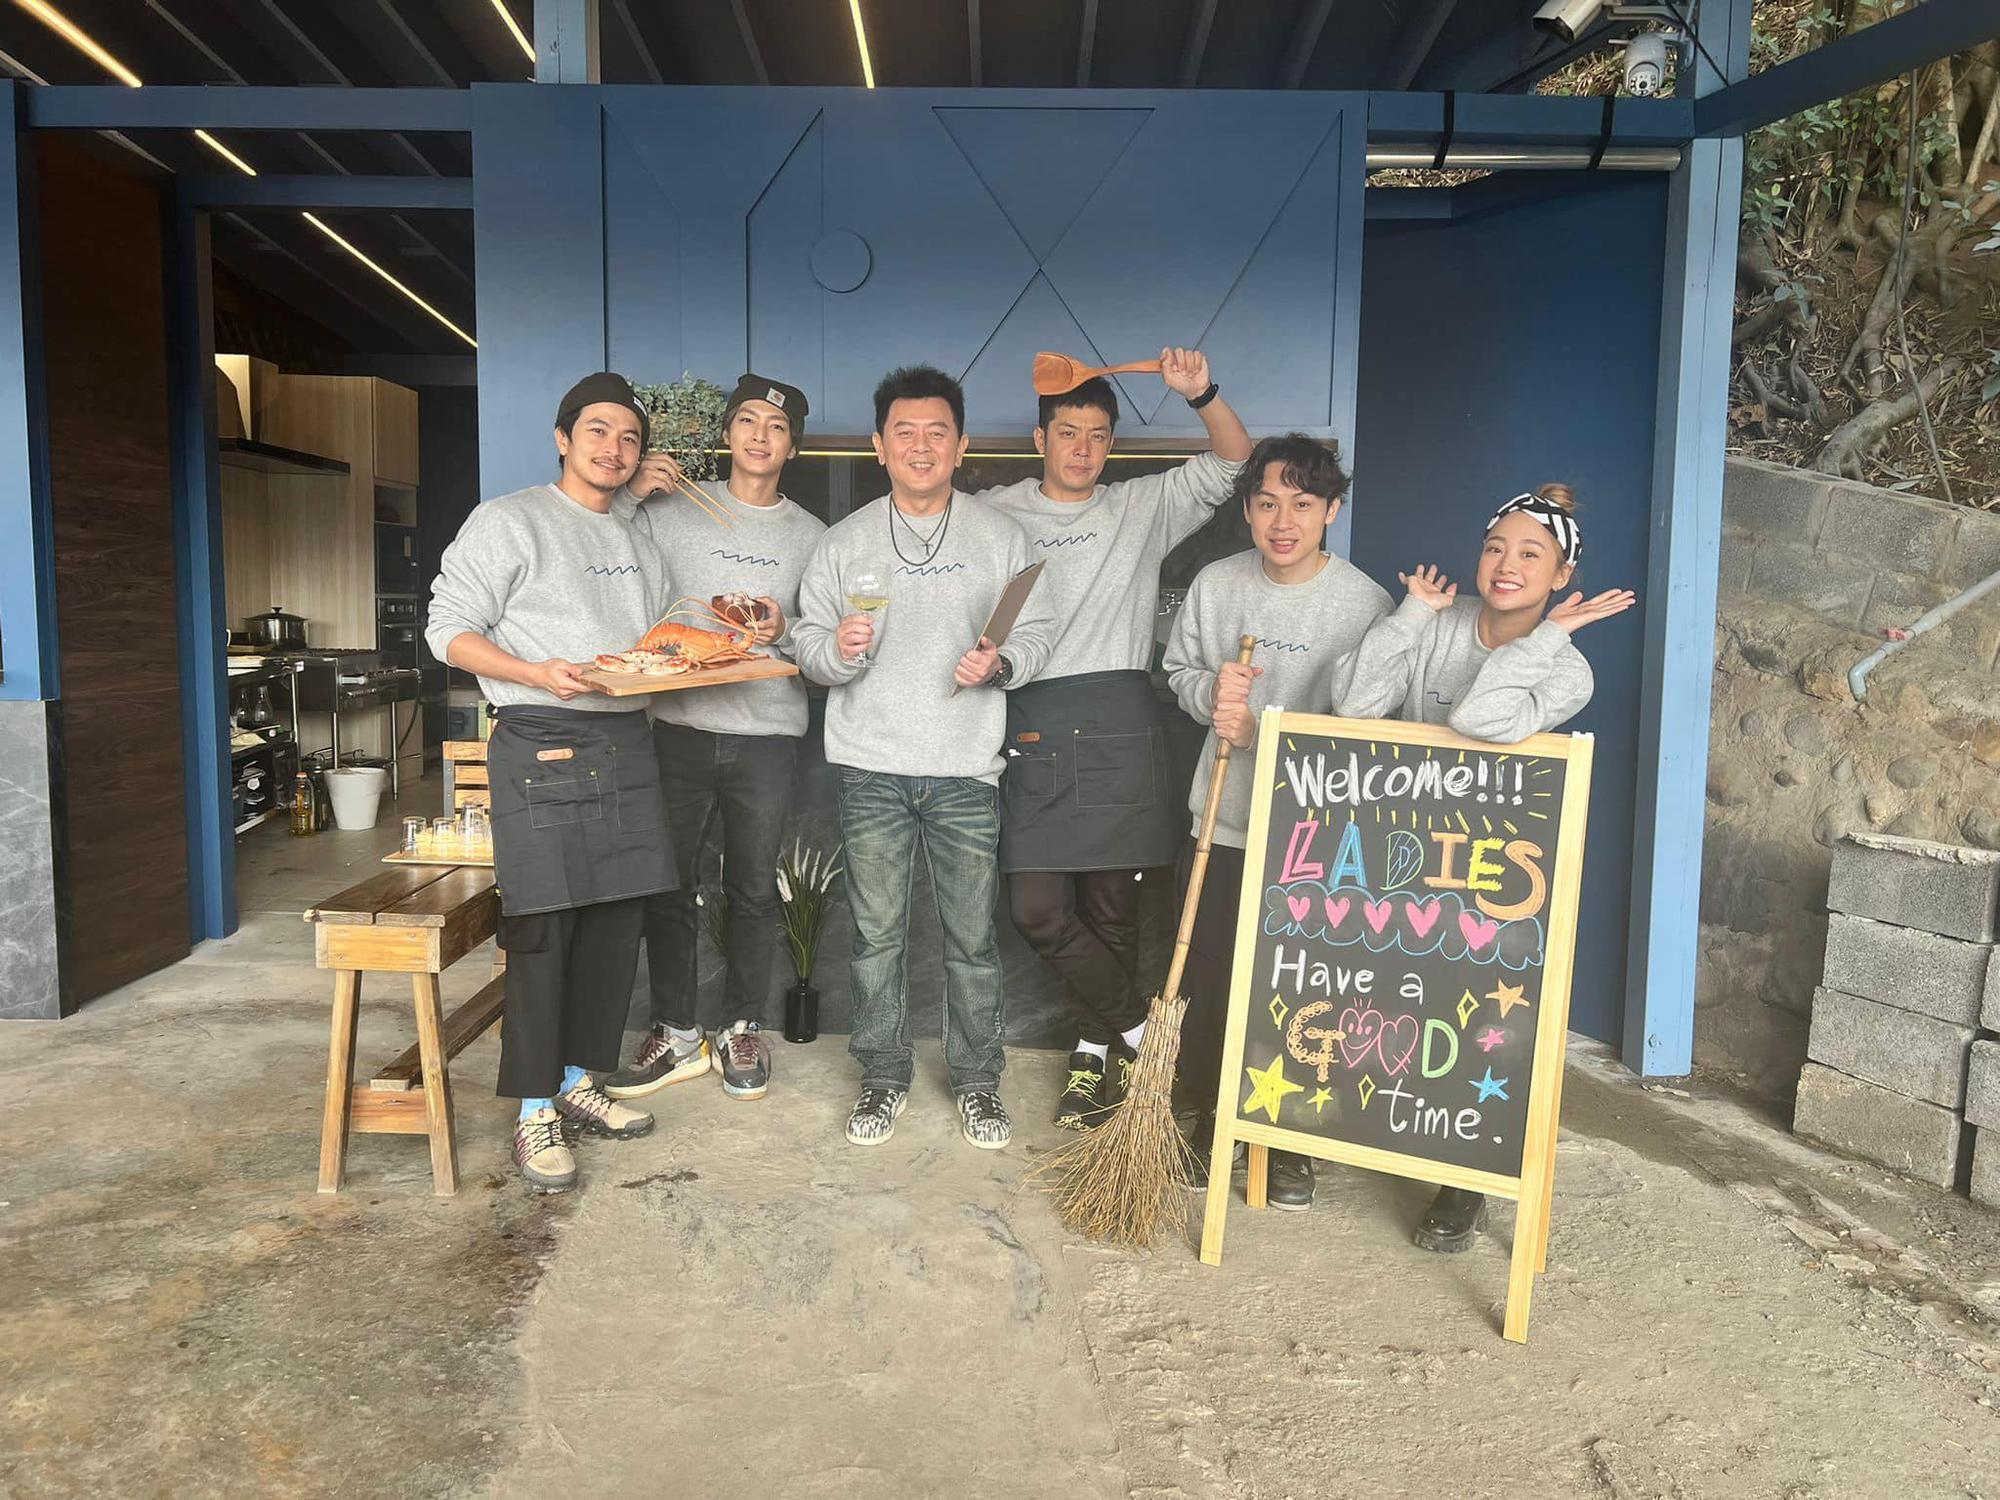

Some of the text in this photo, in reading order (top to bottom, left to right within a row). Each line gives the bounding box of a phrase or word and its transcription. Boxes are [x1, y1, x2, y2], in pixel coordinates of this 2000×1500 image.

[1279, 821, 1546, 920] LADIES
[1270, 944, 1424, 1005] Have a
[1286, 1000, 1459, 1083] GOOD
[1377, 1078, 1503, 1144] time.
